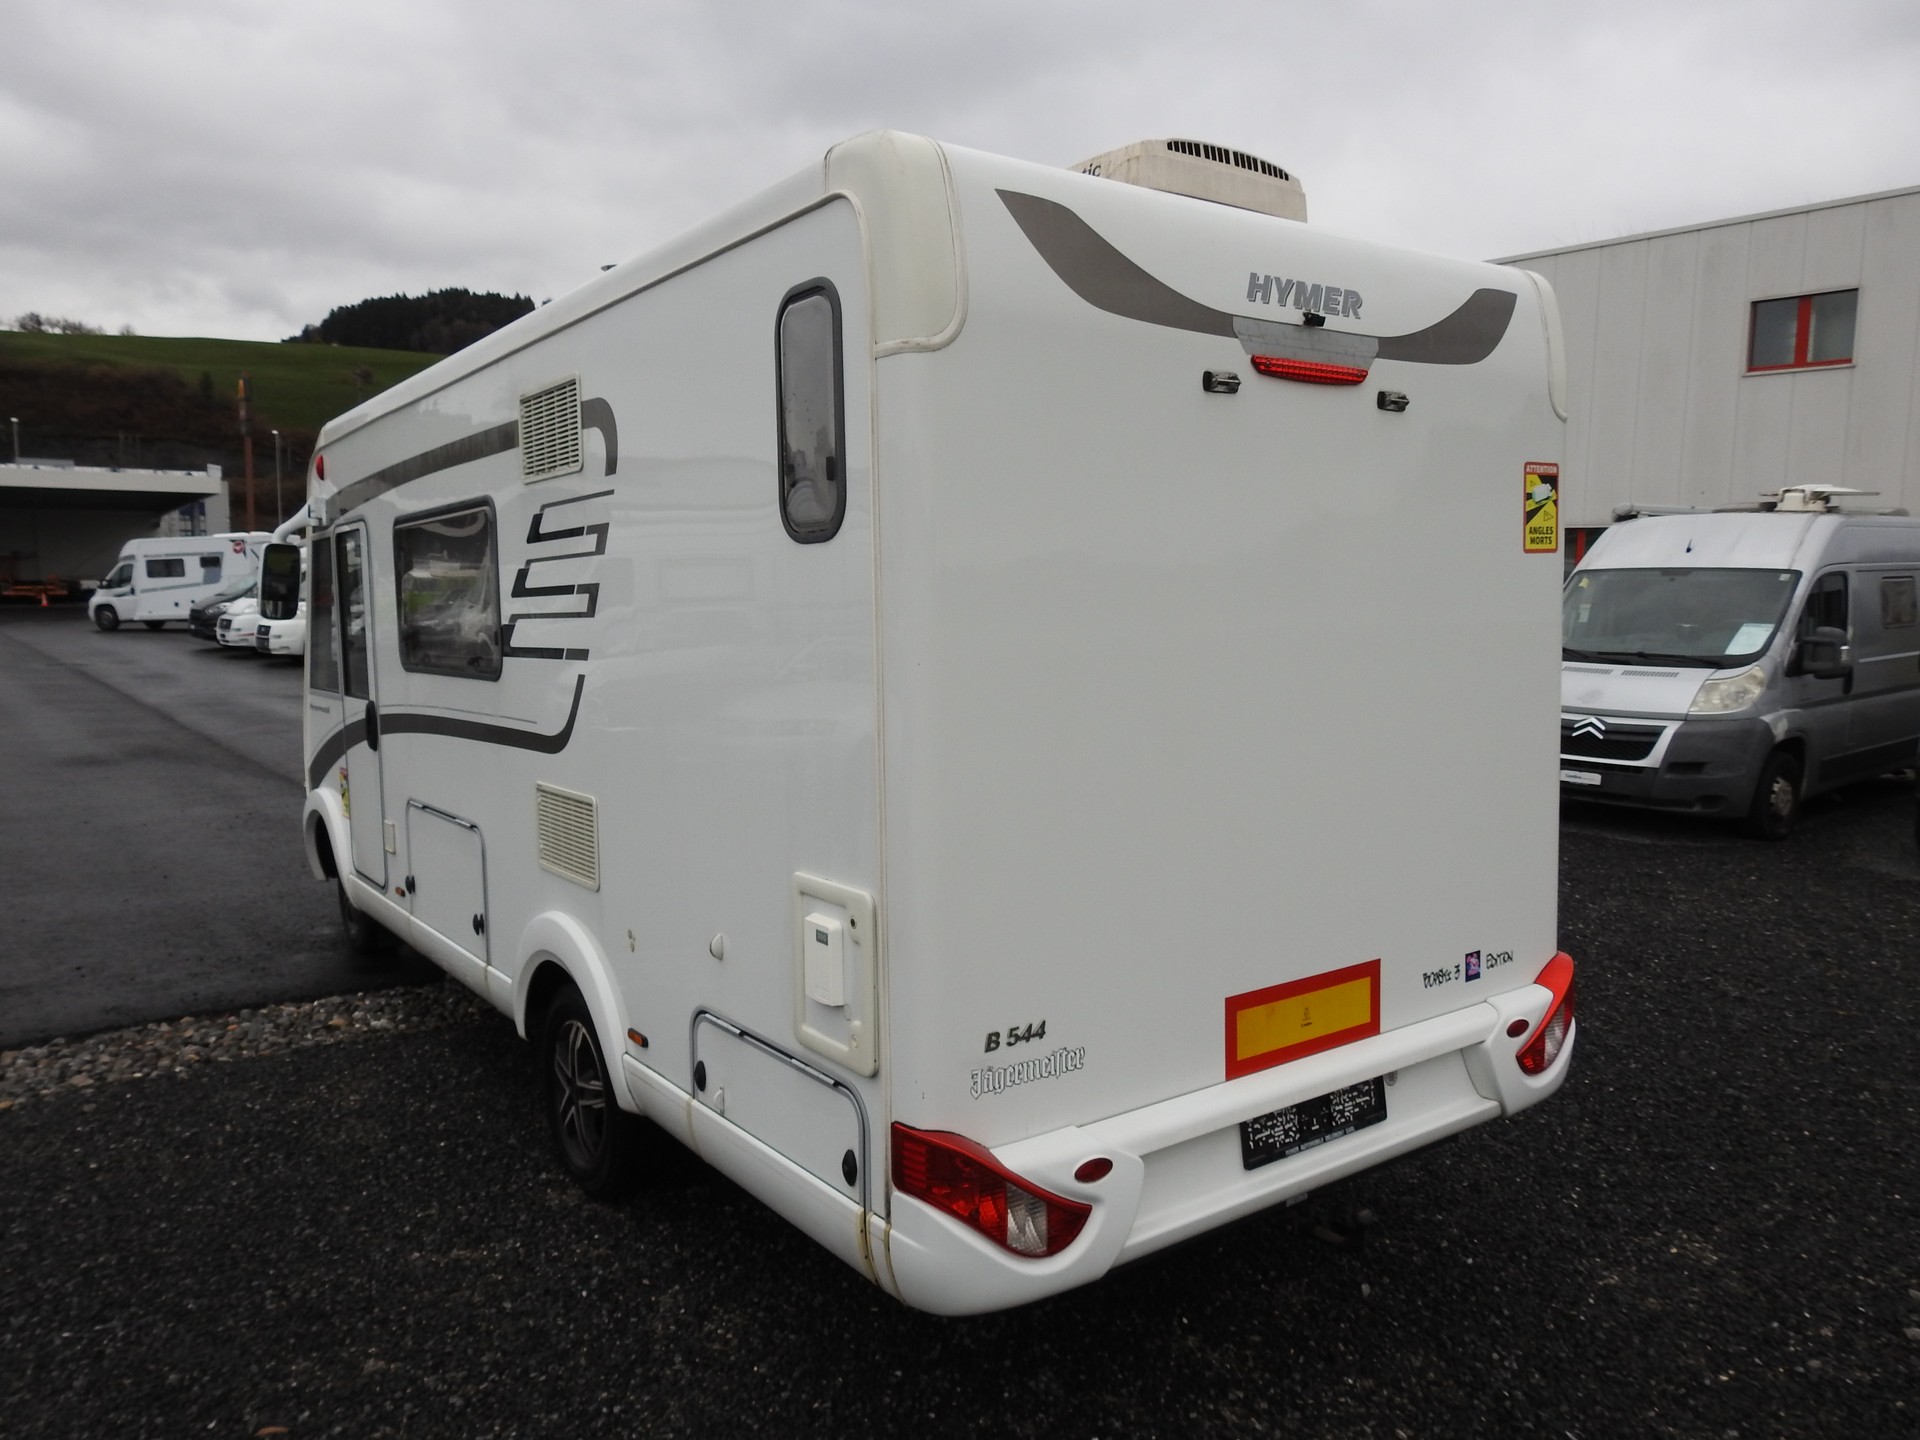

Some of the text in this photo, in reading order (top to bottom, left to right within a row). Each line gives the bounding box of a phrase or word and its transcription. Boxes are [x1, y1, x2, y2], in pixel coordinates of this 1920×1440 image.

[1246, 272, 1363, 319] HYMER
[1528, 526, 1554, 535] ANGLES
[1529, 536, 1553, 545] MORTS
[984, 1020, 1047, 1053] B 544
